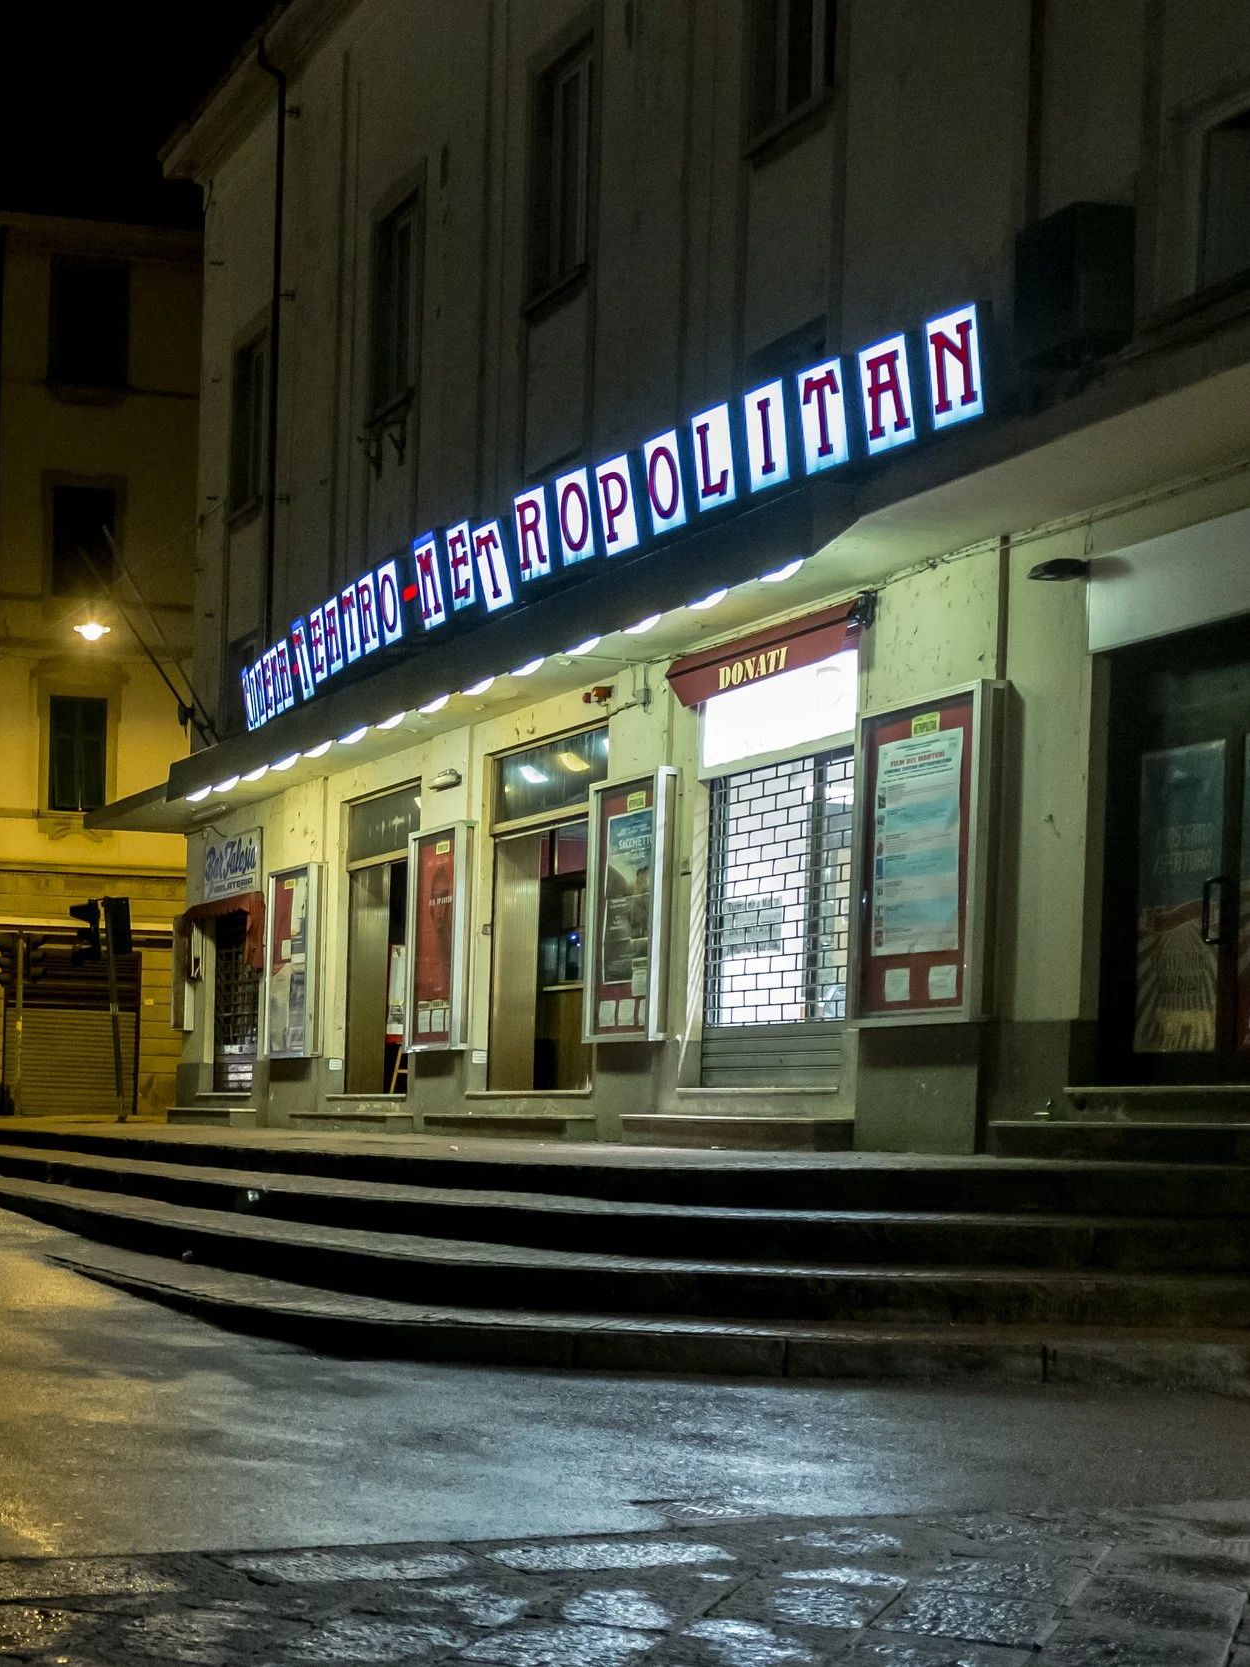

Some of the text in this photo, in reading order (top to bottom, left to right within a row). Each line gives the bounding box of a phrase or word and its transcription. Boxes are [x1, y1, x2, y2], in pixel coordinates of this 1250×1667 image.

[416, 318, 979, 620] METROPOLITAN
[717, 646, 790, 691] DONATI
[205, 846, 223, 882] Bar
[214, 877, 253, 893] GELATERIA
